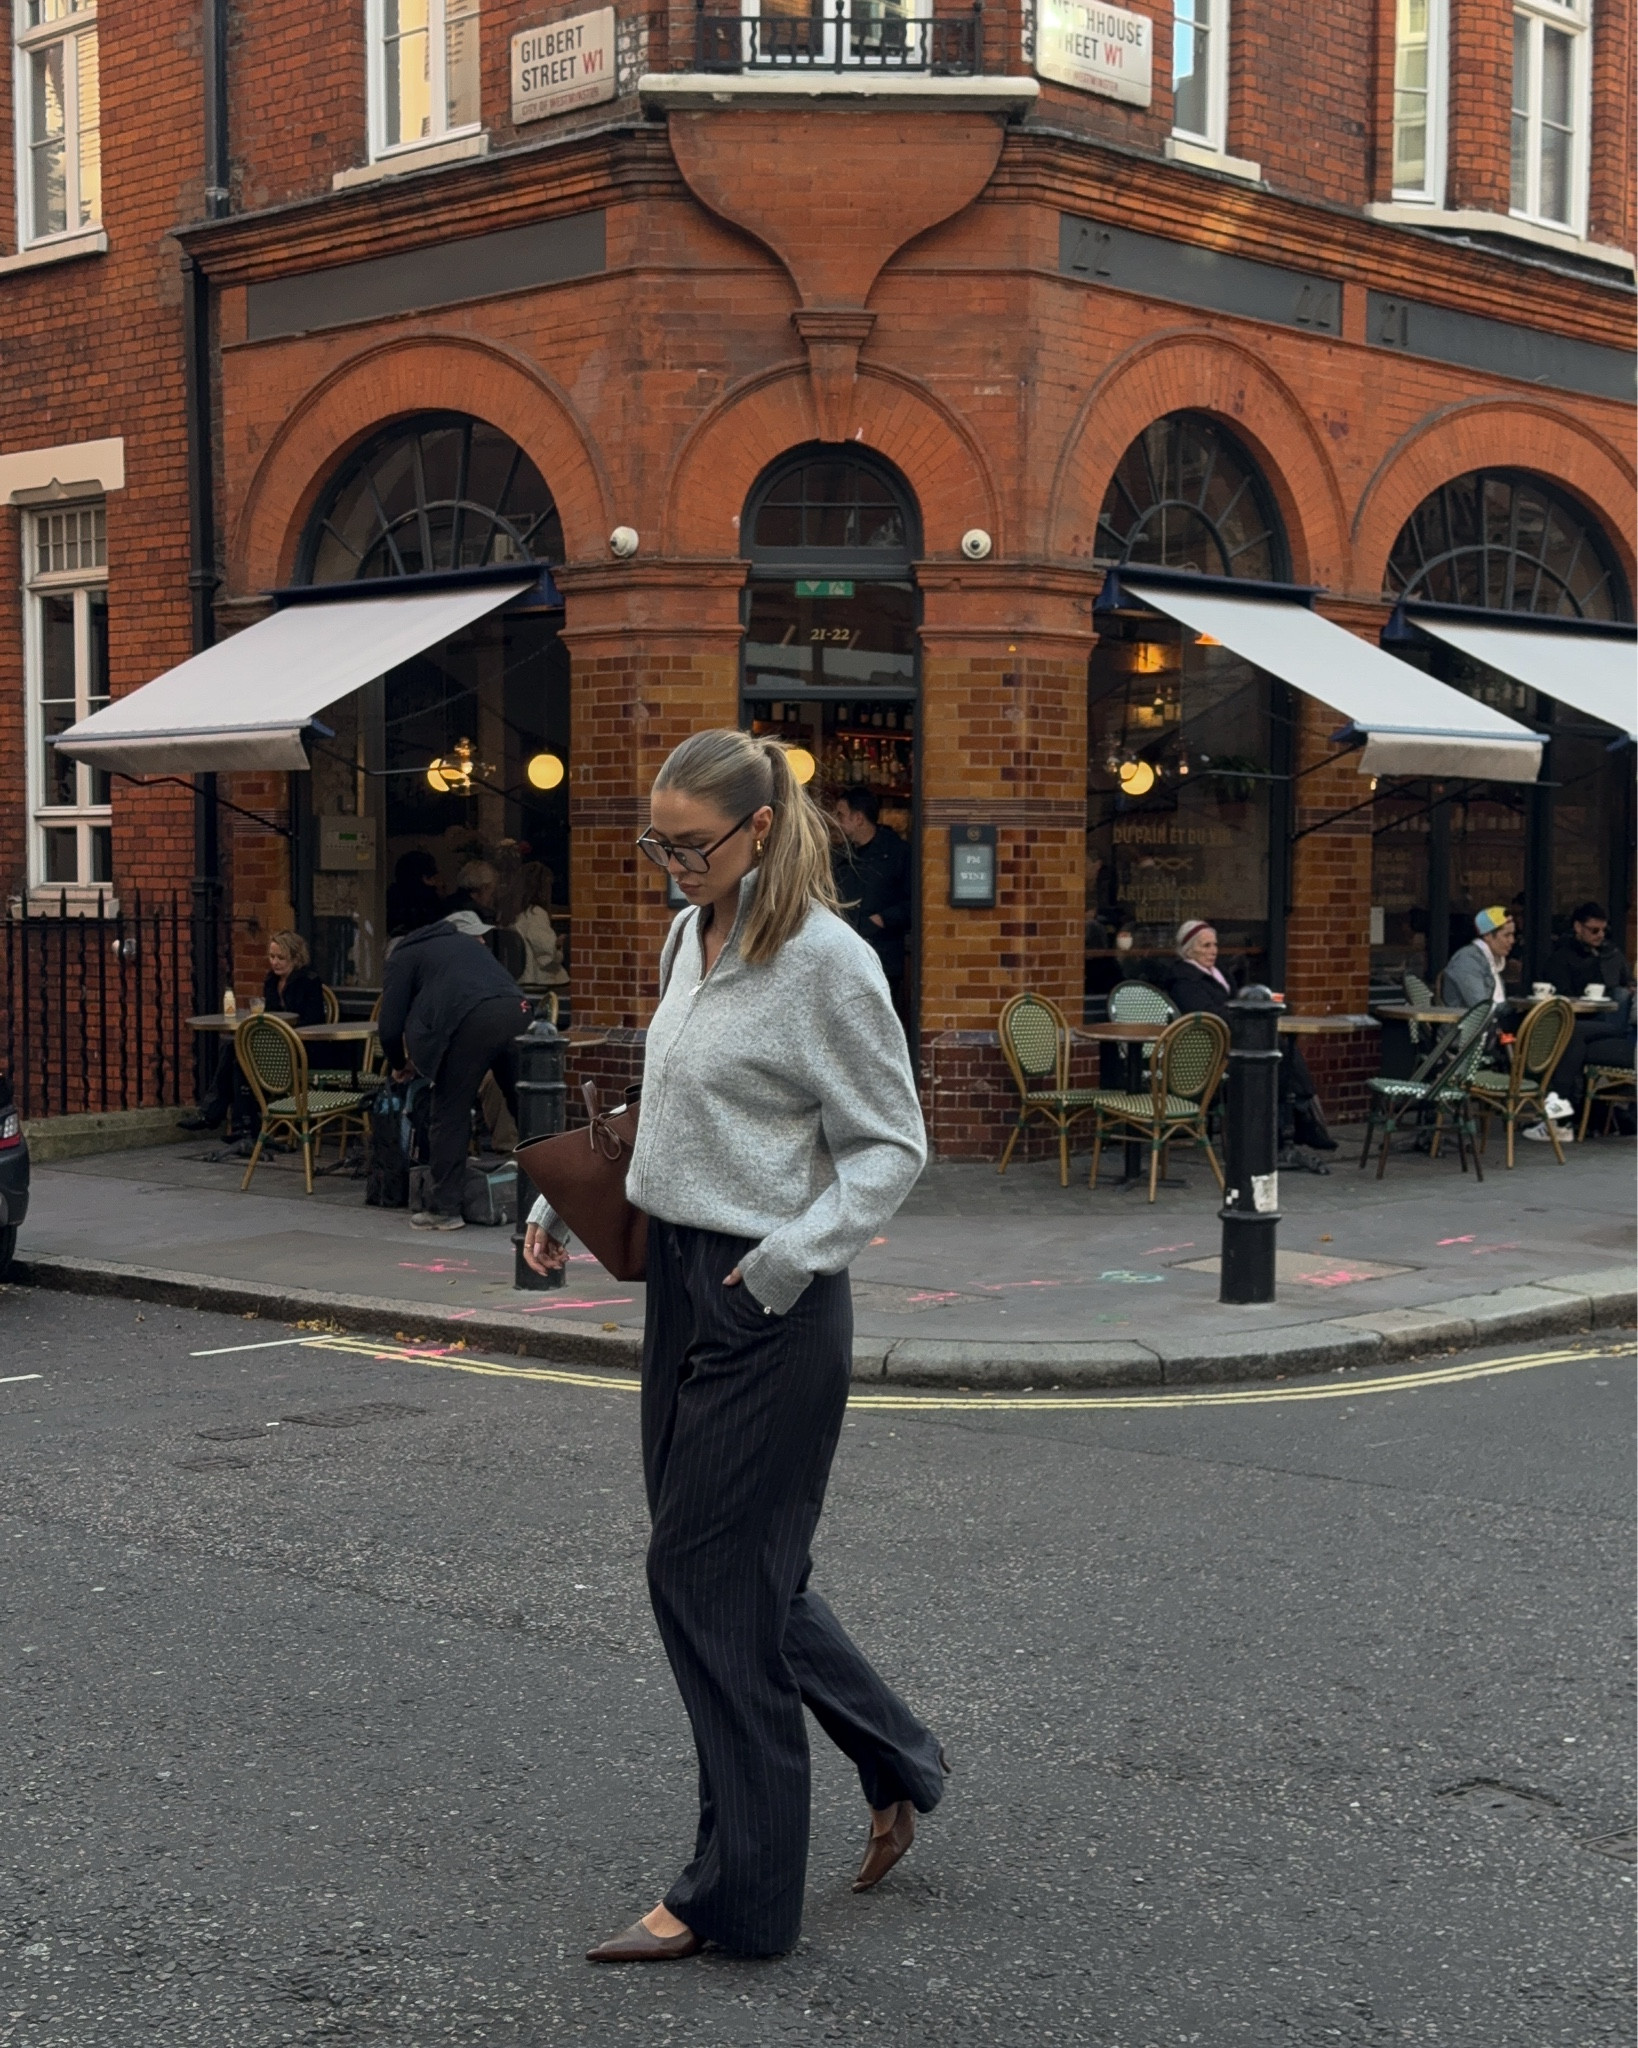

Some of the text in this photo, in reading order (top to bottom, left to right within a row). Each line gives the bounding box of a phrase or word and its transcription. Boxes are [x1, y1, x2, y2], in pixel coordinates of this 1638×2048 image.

[1052, 0, 1143, 46] HHOUSE
[521, 25, 584, 64] GILBERT
[1103, 42, 1123, 68] W1
[521, 48, 604, 92] STREET W1
[810, 628, 850, 641] 21-22
[1169, 826, 1186, 844] ET
